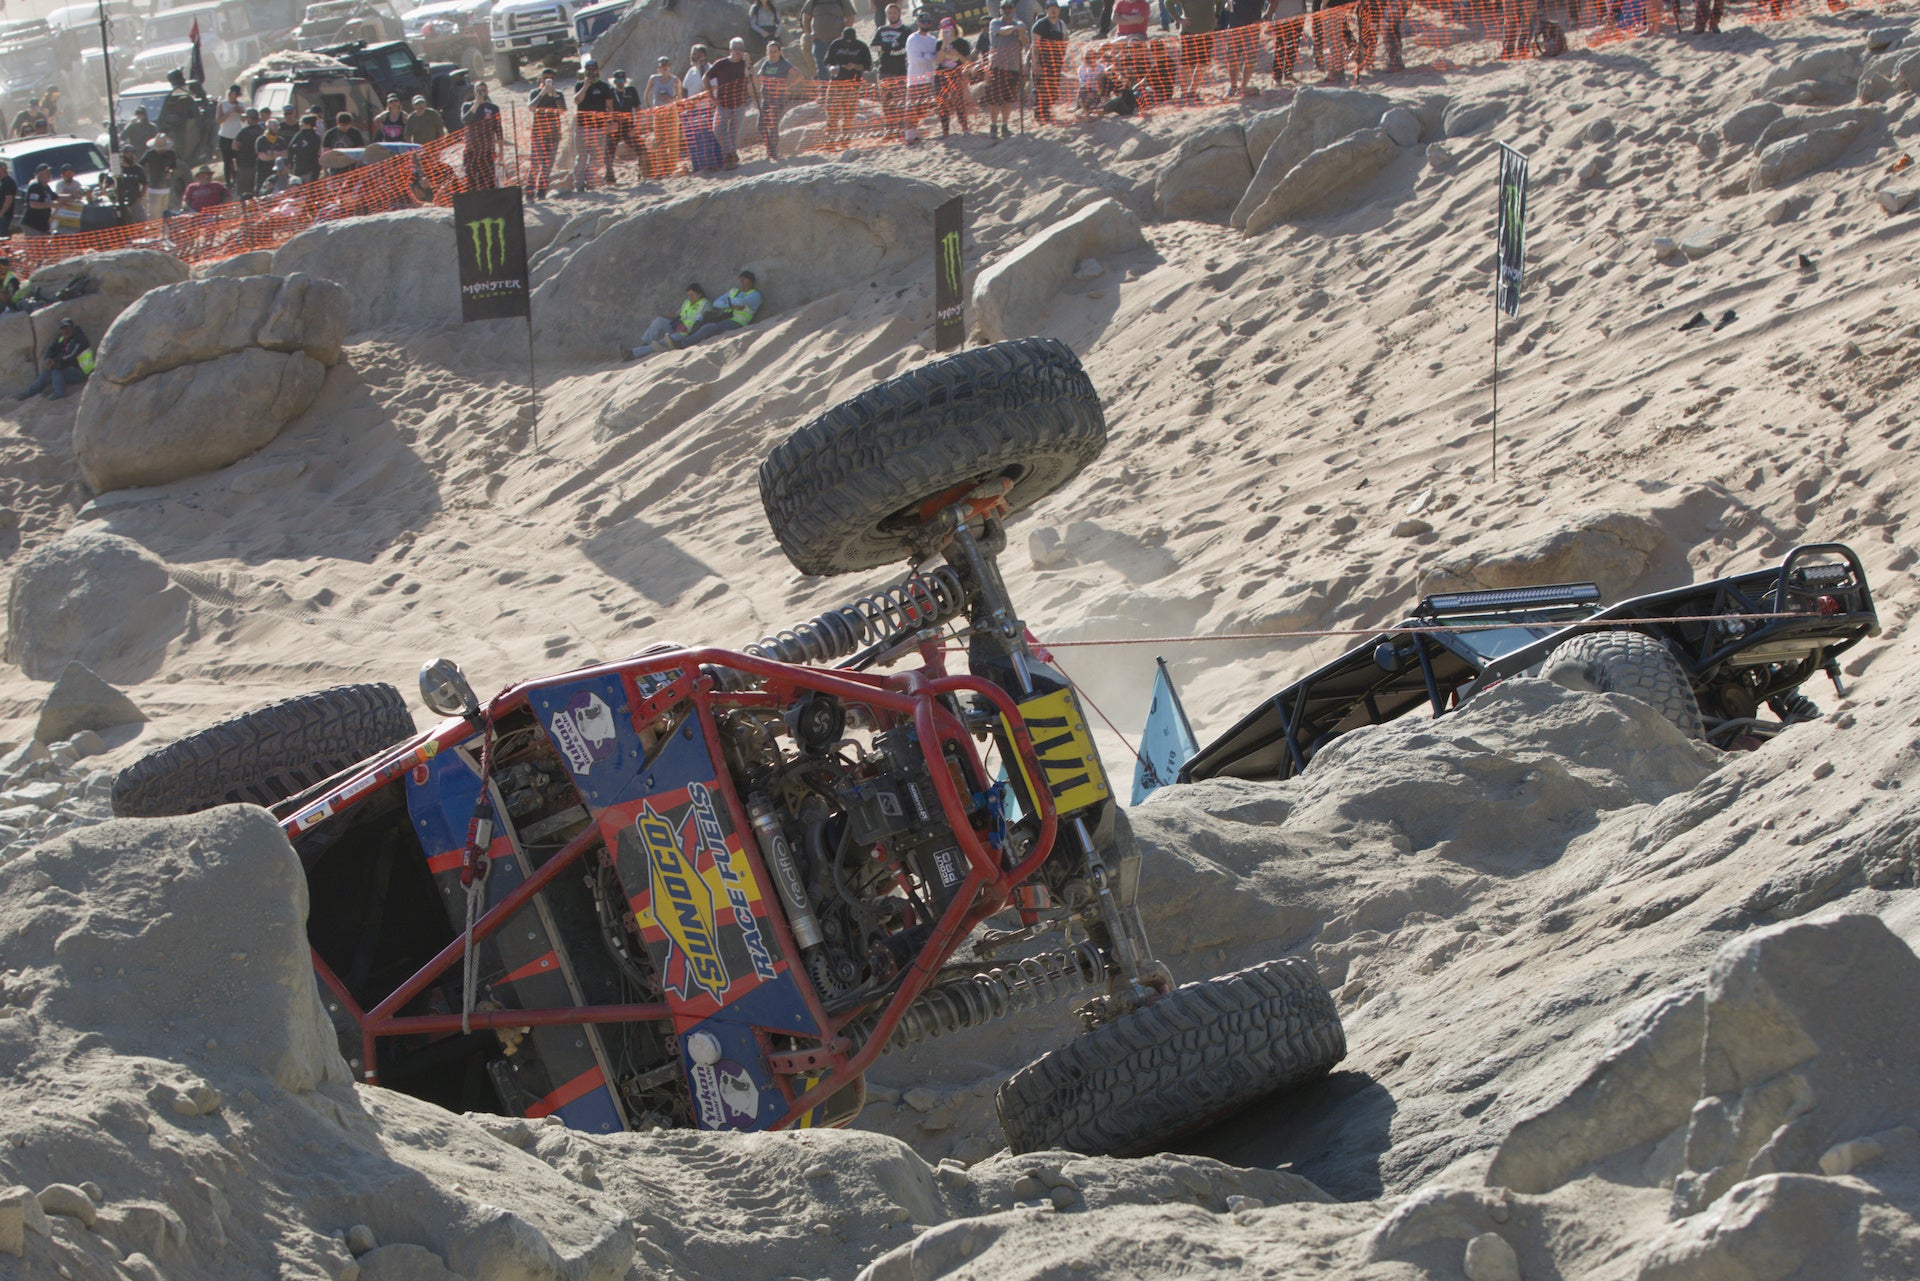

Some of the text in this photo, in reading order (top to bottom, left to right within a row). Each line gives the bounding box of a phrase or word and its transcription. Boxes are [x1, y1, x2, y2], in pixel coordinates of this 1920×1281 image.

[555, 718, 585, 771] Yukon
[1023, 716, 1091, 798] 1717
[688, 781, 777, 982] RACE FUELS
[777, 842, 804, 900] radflo
[941, 851, 957, 882] PRO
[644, 822, 723, 984] SUNOCO
[697, 1066, 716, 1121] Yukon
